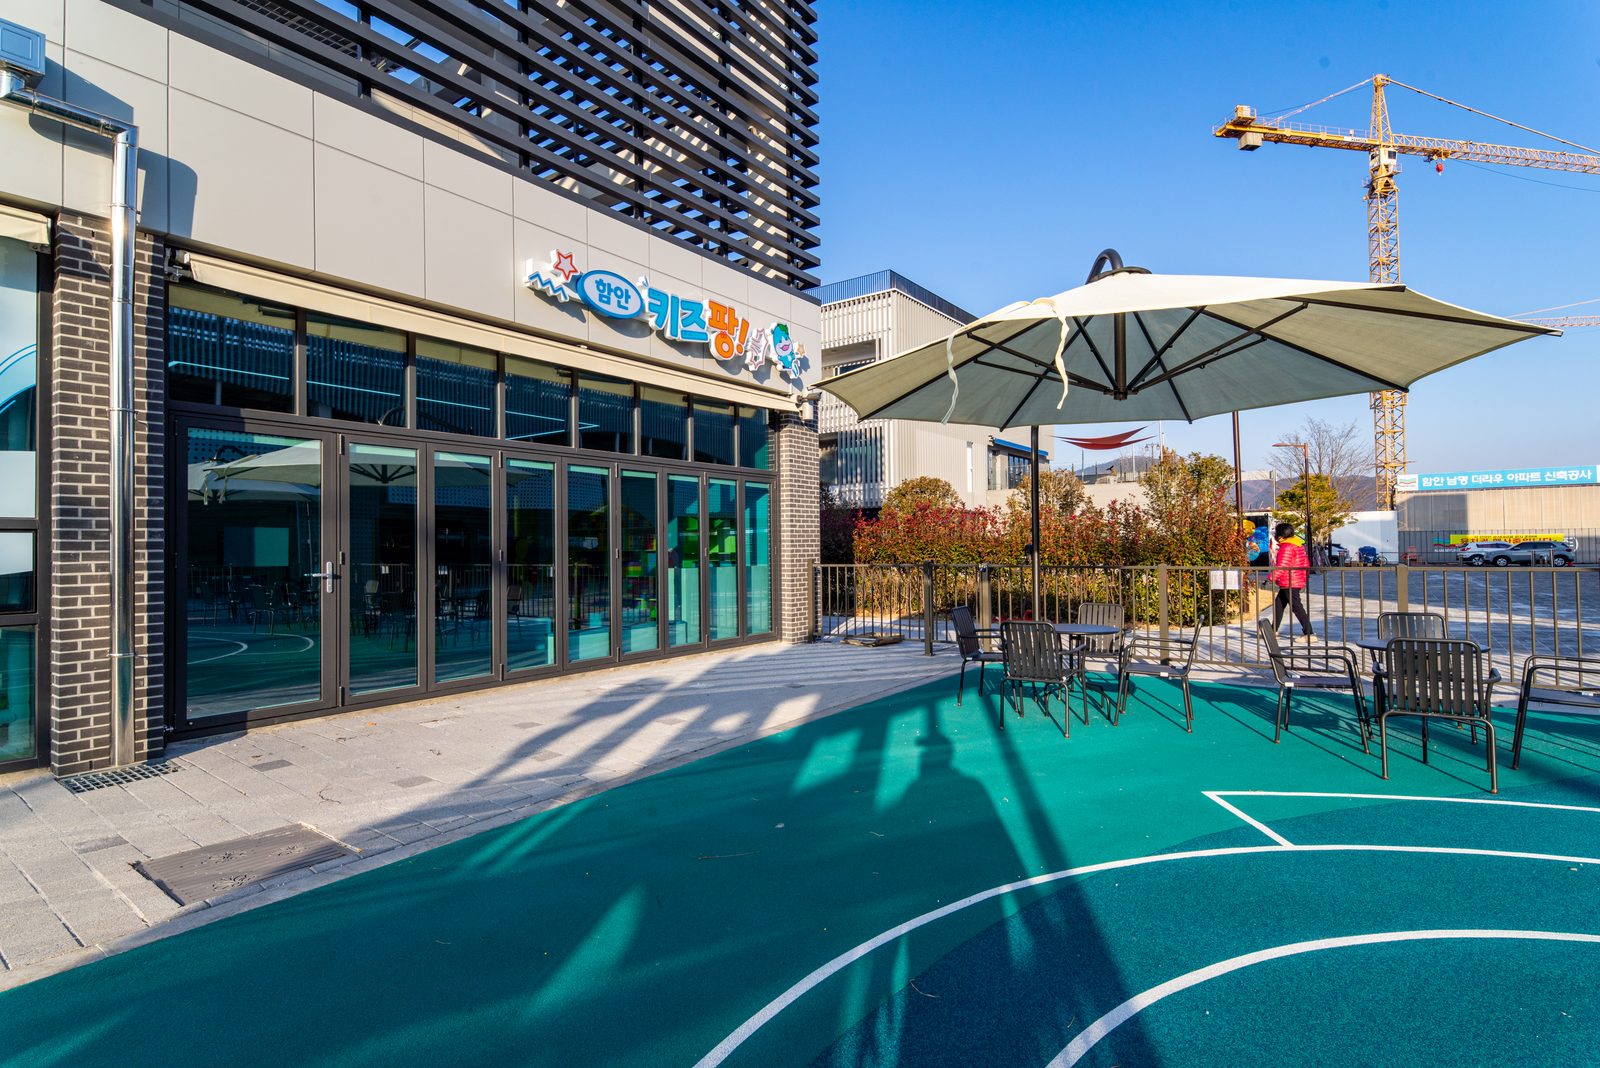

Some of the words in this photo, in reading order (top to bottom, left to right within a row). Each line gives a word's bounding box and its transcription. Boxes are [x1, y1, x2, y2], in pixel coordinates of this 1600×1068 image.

[595, 278, 631, 311] 함안
[1422, 476, 1445, 487] 함안
[1506, 471, 1541, 483] 아파트
[1544, 469, 1592, 481] 신축공사
